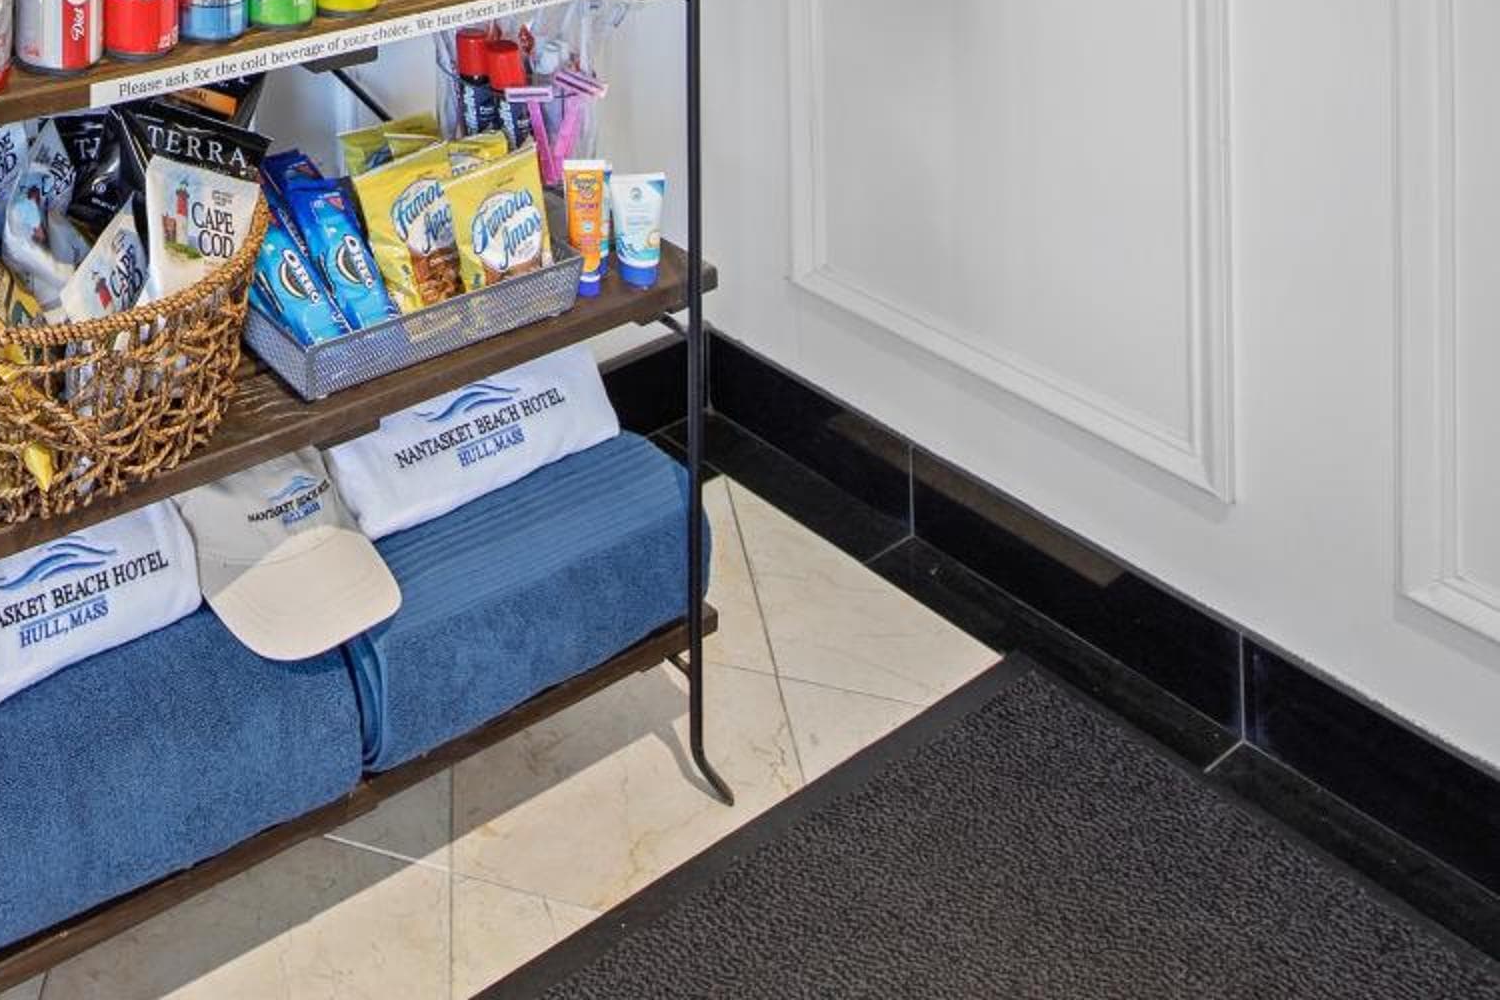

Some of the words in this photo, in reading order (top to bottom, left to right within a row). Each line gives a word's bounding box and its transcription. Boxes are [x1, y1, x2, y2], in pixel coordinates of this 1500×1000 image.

[71, 8, 85, 41] Diet
[119, 78, 163, 97] Please
[165, 72, 189, 87] ask
[193, 66, 212, 82] for
[215, 60, 237, 76] the
[240, 53, 267, 70] cold
[271, 41, 326, 66] beverage
[327, 36, 341, 51] of
[341, 32, 372, 50] your
[372, 21, 413, 41] choice.
[416, 18, 434, 31] We
[437, 11, 462, 27] have
[465, 4, 495, 23] them
[497, 1, 510, 13] in
[148, 124, 249, 169] TERRA
[191, 201, 235, 236] CAPE
[199, 228, 235, 259] COD
[472, 187, 533, 255] Famous
[500, 213, 542, 271] Amos
[284, 249, 320, 303] OREO
[344, 235, 373, 289] OREO
[394, 420, 472, 469] NANTASKET
[476, 400, 520, 436] BEACH
[520, 386, 566, 418] HOTEL
[457, 443, 494, 468] HULL,
[494, 426, 526, 453] MASS
[51, 572, 110, 616] BEACH
[112, 549, 169, 590] HOTEL
[18, 617, 69, 649] HULL,
[69, 598, 110, 629] MASS
